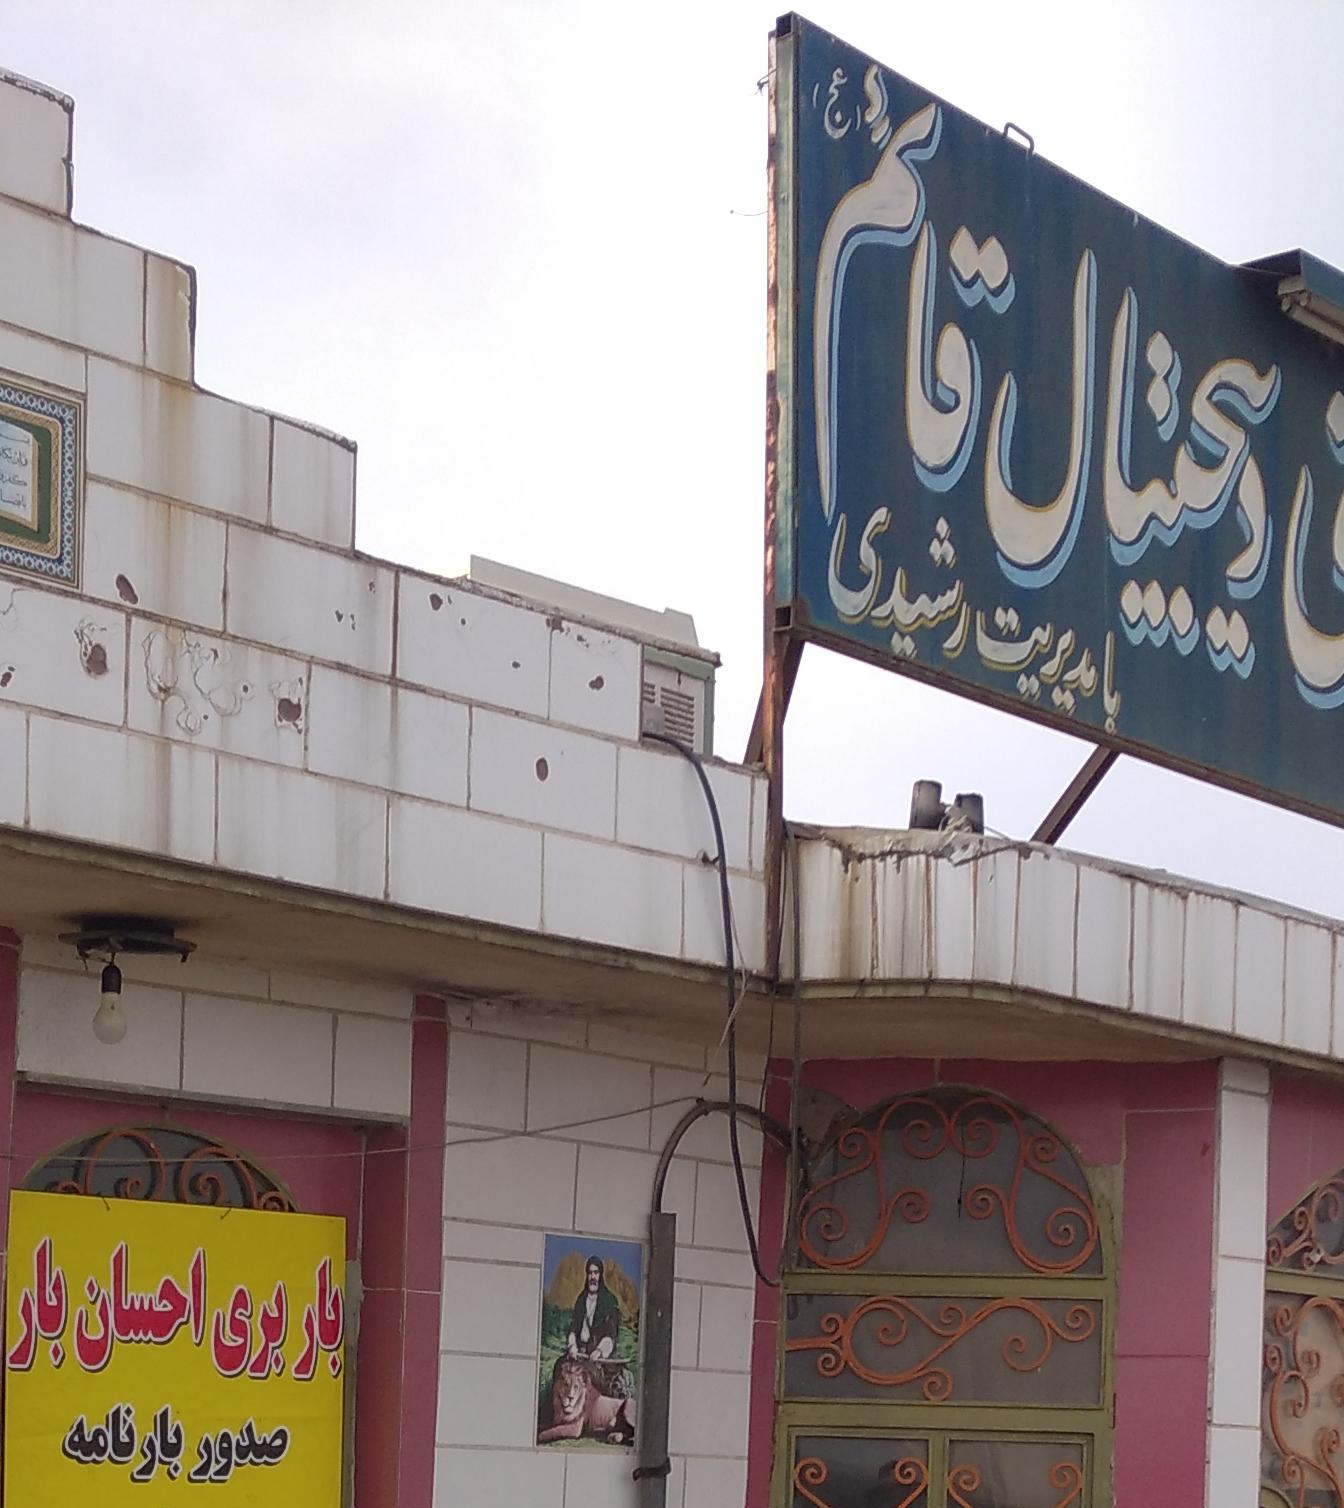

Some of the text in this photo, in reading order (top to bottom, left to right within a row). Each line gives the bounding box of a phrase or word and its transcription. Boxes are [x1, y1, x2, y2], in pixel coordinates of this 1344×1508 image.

[985, 248, 1281, 679] دیجیتال
[828, 506, 970, 659] رشیدی
[976, 607, 1098, 715] مدیریت
[7, 1237, 66, 1371] بار
[73, 1241, 205, 1371] احسان
[189, 1417, 290, 1483] صدور
